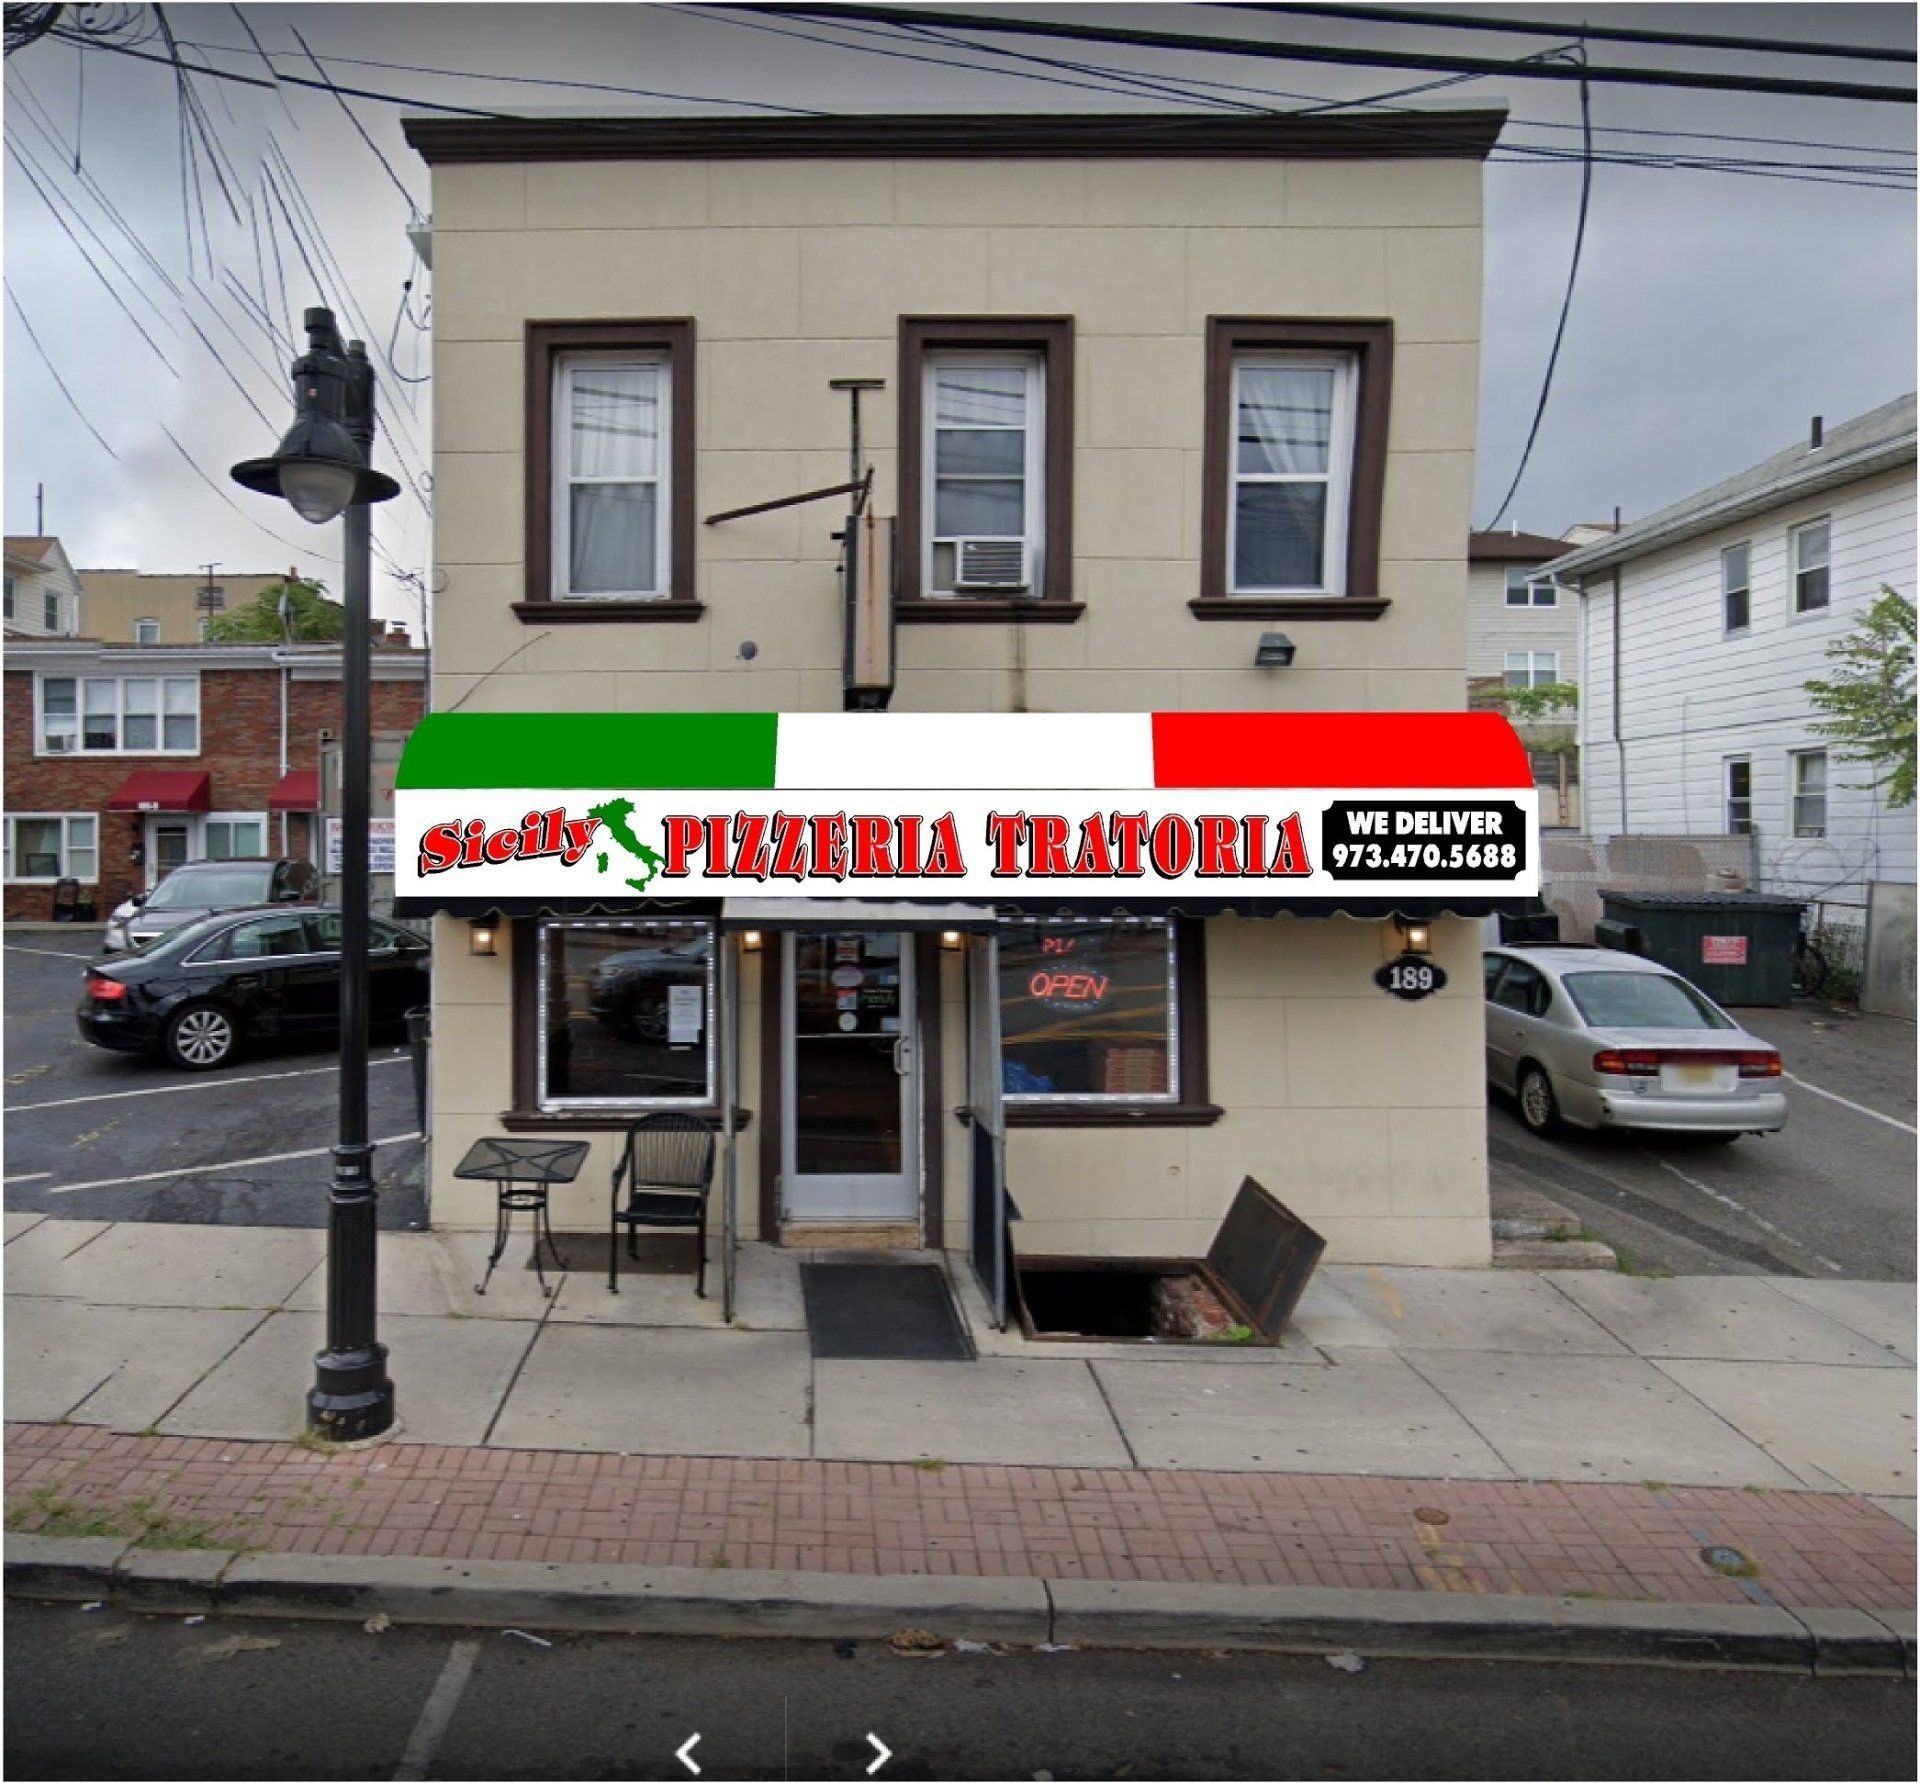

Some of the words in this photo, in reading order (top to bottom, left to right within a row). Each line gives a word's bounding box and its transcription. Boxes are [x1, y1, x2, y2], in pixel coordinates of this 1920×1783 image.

[1346, 811, 1389, 835] WE
[1395, 811, 1504, 835] DELIVER
[417, 806, 603, 879] Sicily
[661, 809, 968, 884] PIZZERIA
[985, 810, 1314, 881] TRATORIA
[1332, 843, 1517, 869] 973.470.5688
[1030, 972, 1109, 999] OPEN
[1390, 966, 1433, 990] 189
